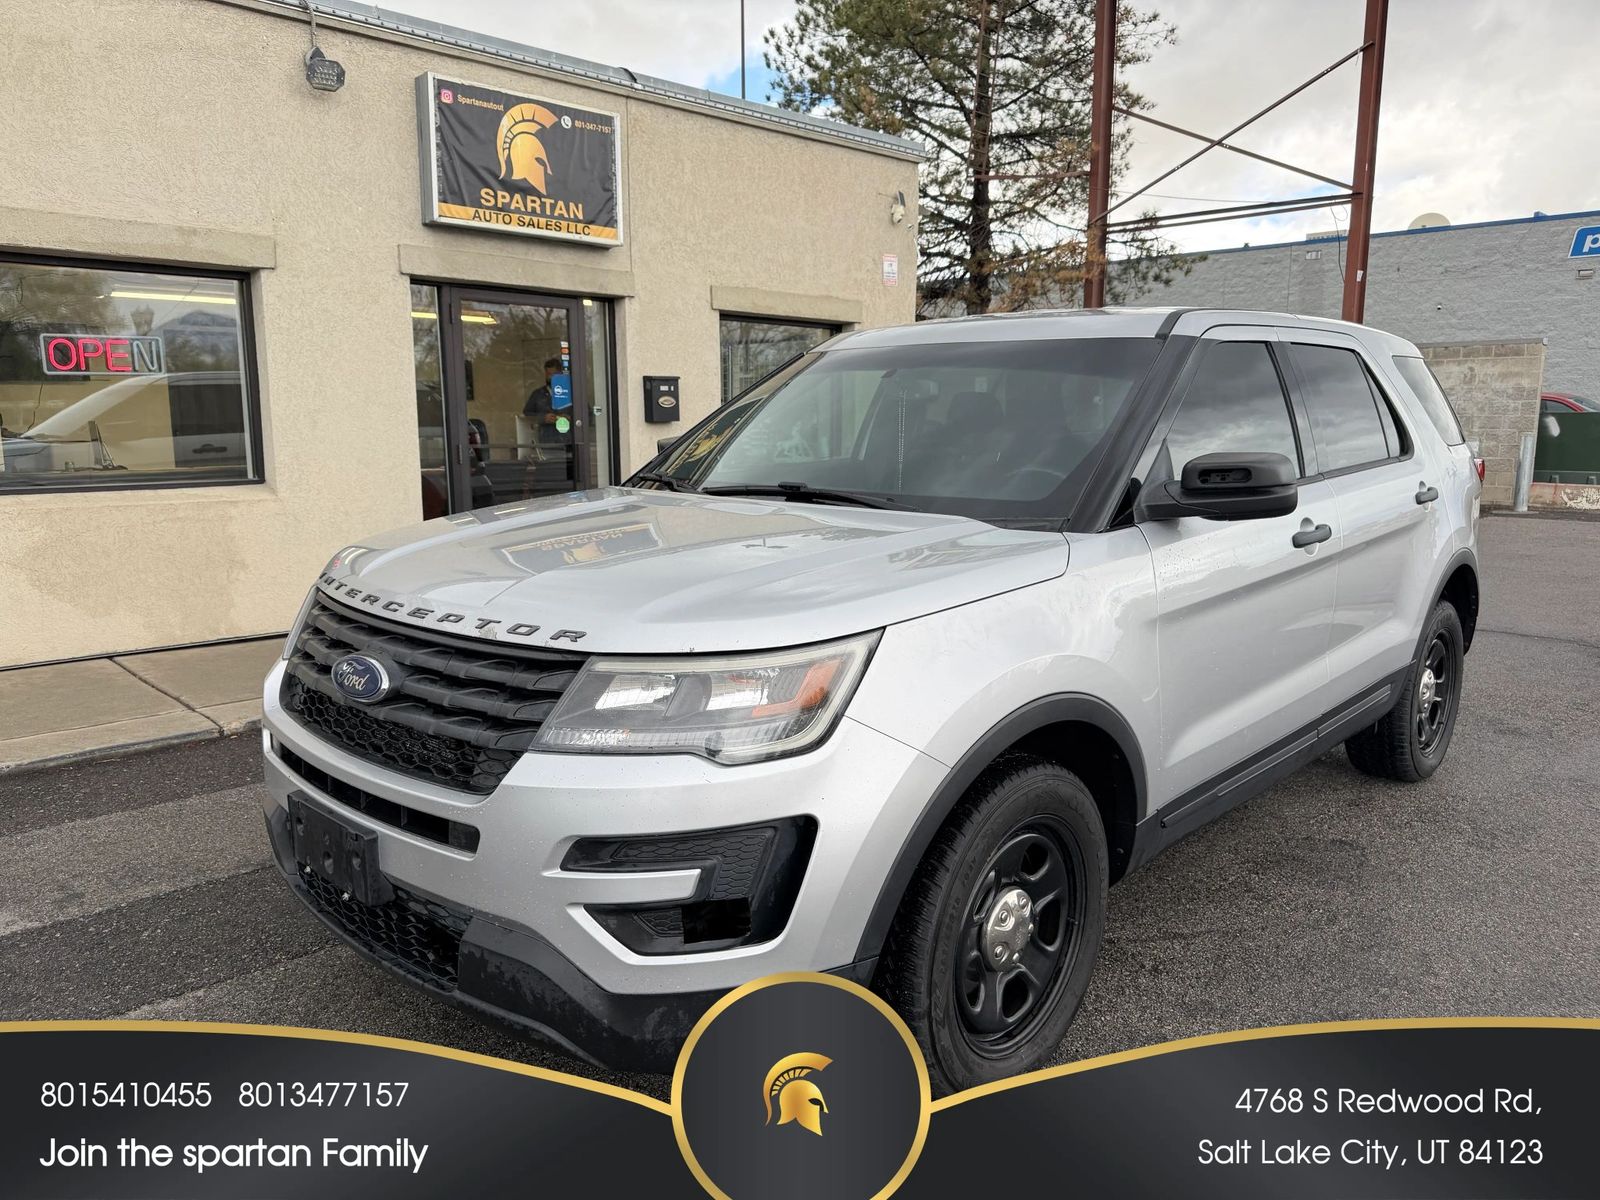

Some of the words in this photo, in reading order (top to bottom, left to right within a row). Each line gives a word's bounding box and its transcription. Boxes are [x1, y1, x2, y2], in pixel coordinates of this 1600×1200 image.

[480, 187, 584, 220] SPARTAN
[472, 210, 513, 225] AUTO
[517, 215, 562, 232] SALES
[566, 221, 591, 236] LLC
[47, 337, 158, 372] OPEN
[318, 572, 588, 643] INTERCEPTOR
[336, 661, 368, 692] Ford
